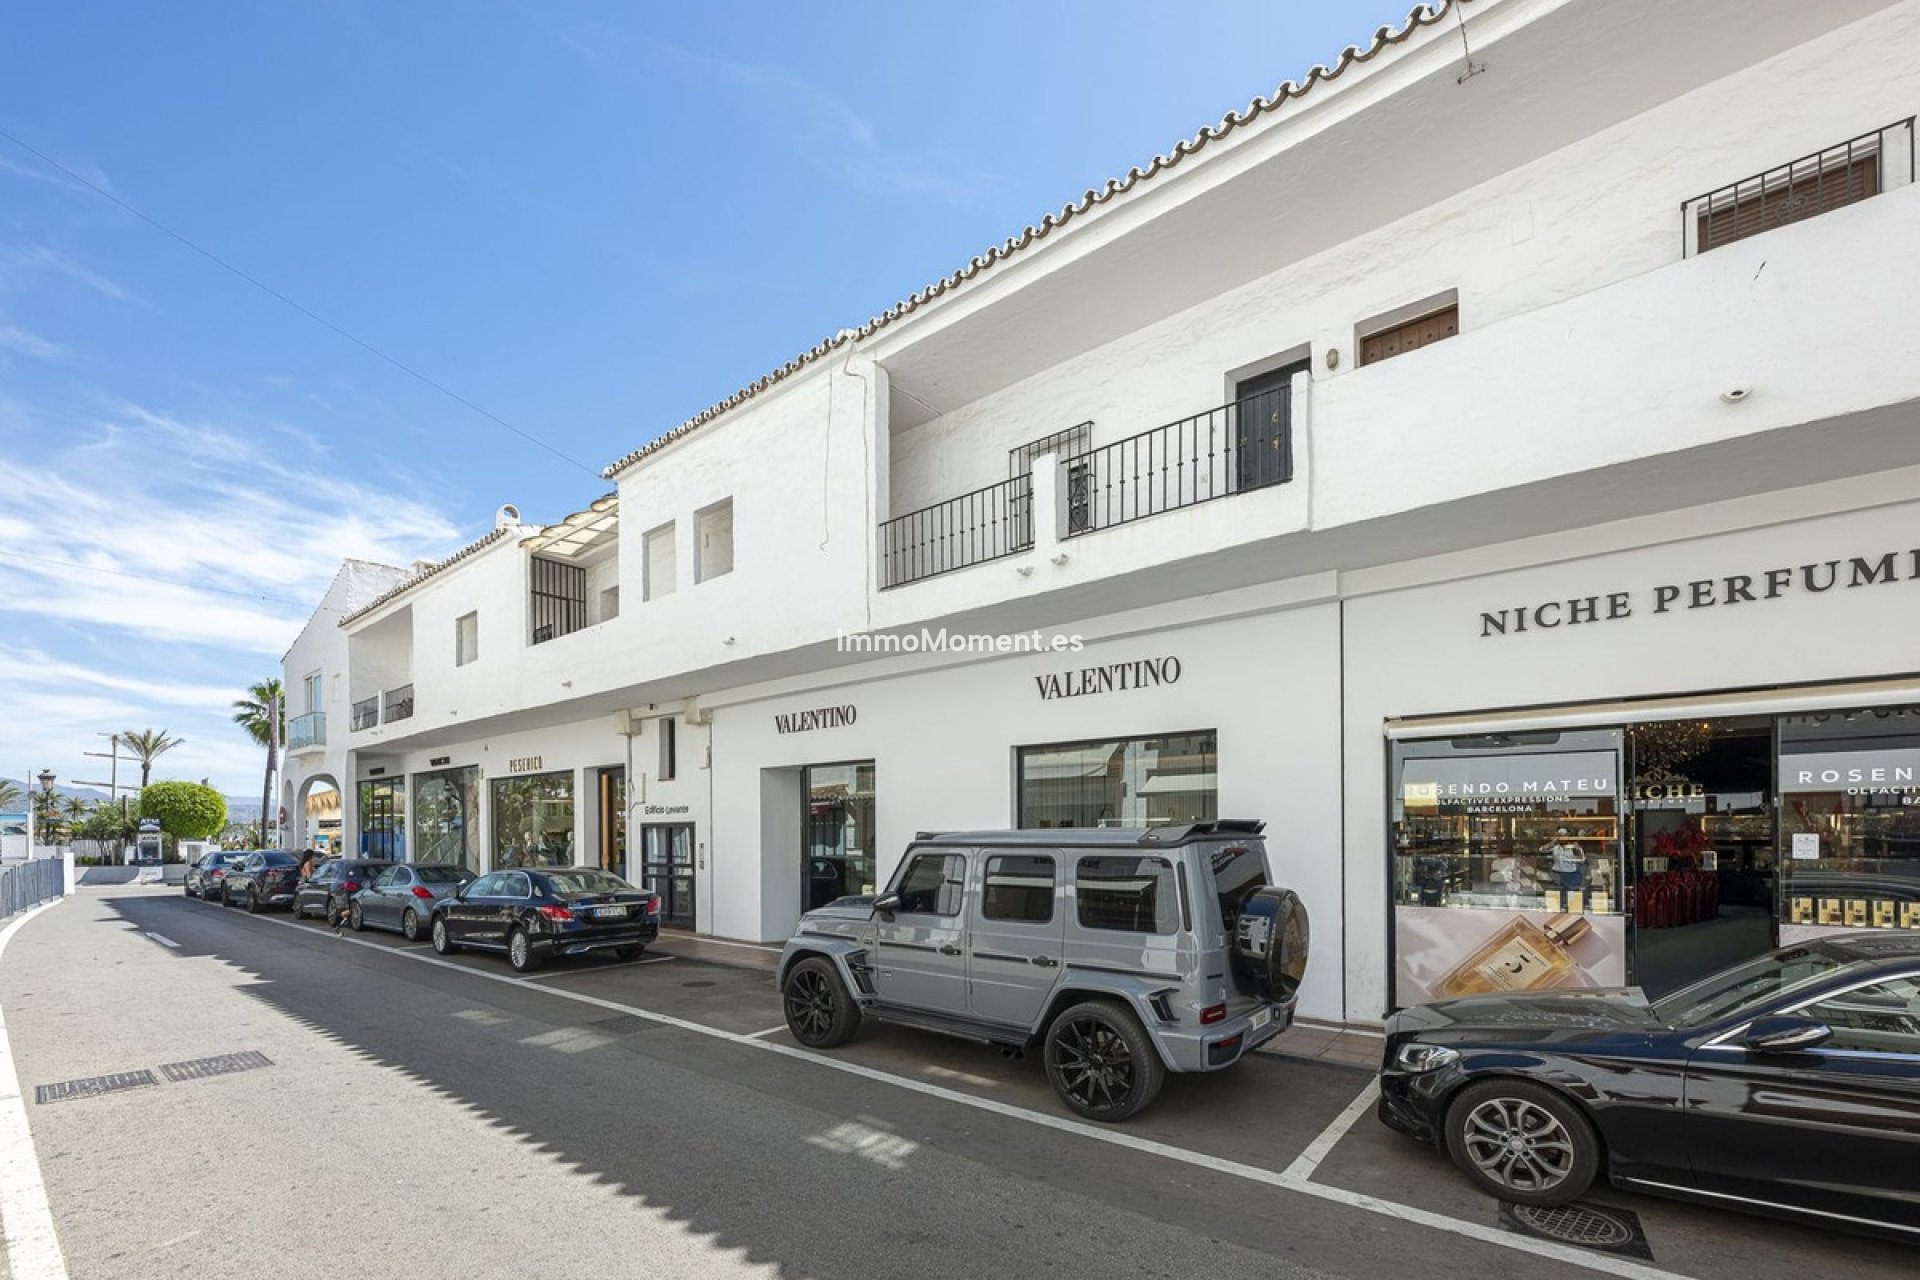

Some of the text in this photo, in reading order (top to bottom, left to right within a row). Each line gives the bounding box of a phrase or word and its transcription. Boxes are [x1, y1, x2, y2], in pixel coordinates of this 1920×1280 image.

[1480, 592, 1631, 637] NICHE
[1035, 656, 1181, 700] VALENTINO
[775, 704, 857, 735] VALENTINO
[1523, 778, 1608, 792] MATEU
[1435, 795, 1570, 806] OLFACTIVE EXPRESSIONS
[1467, 804, 1532, 814] BARCELONA
